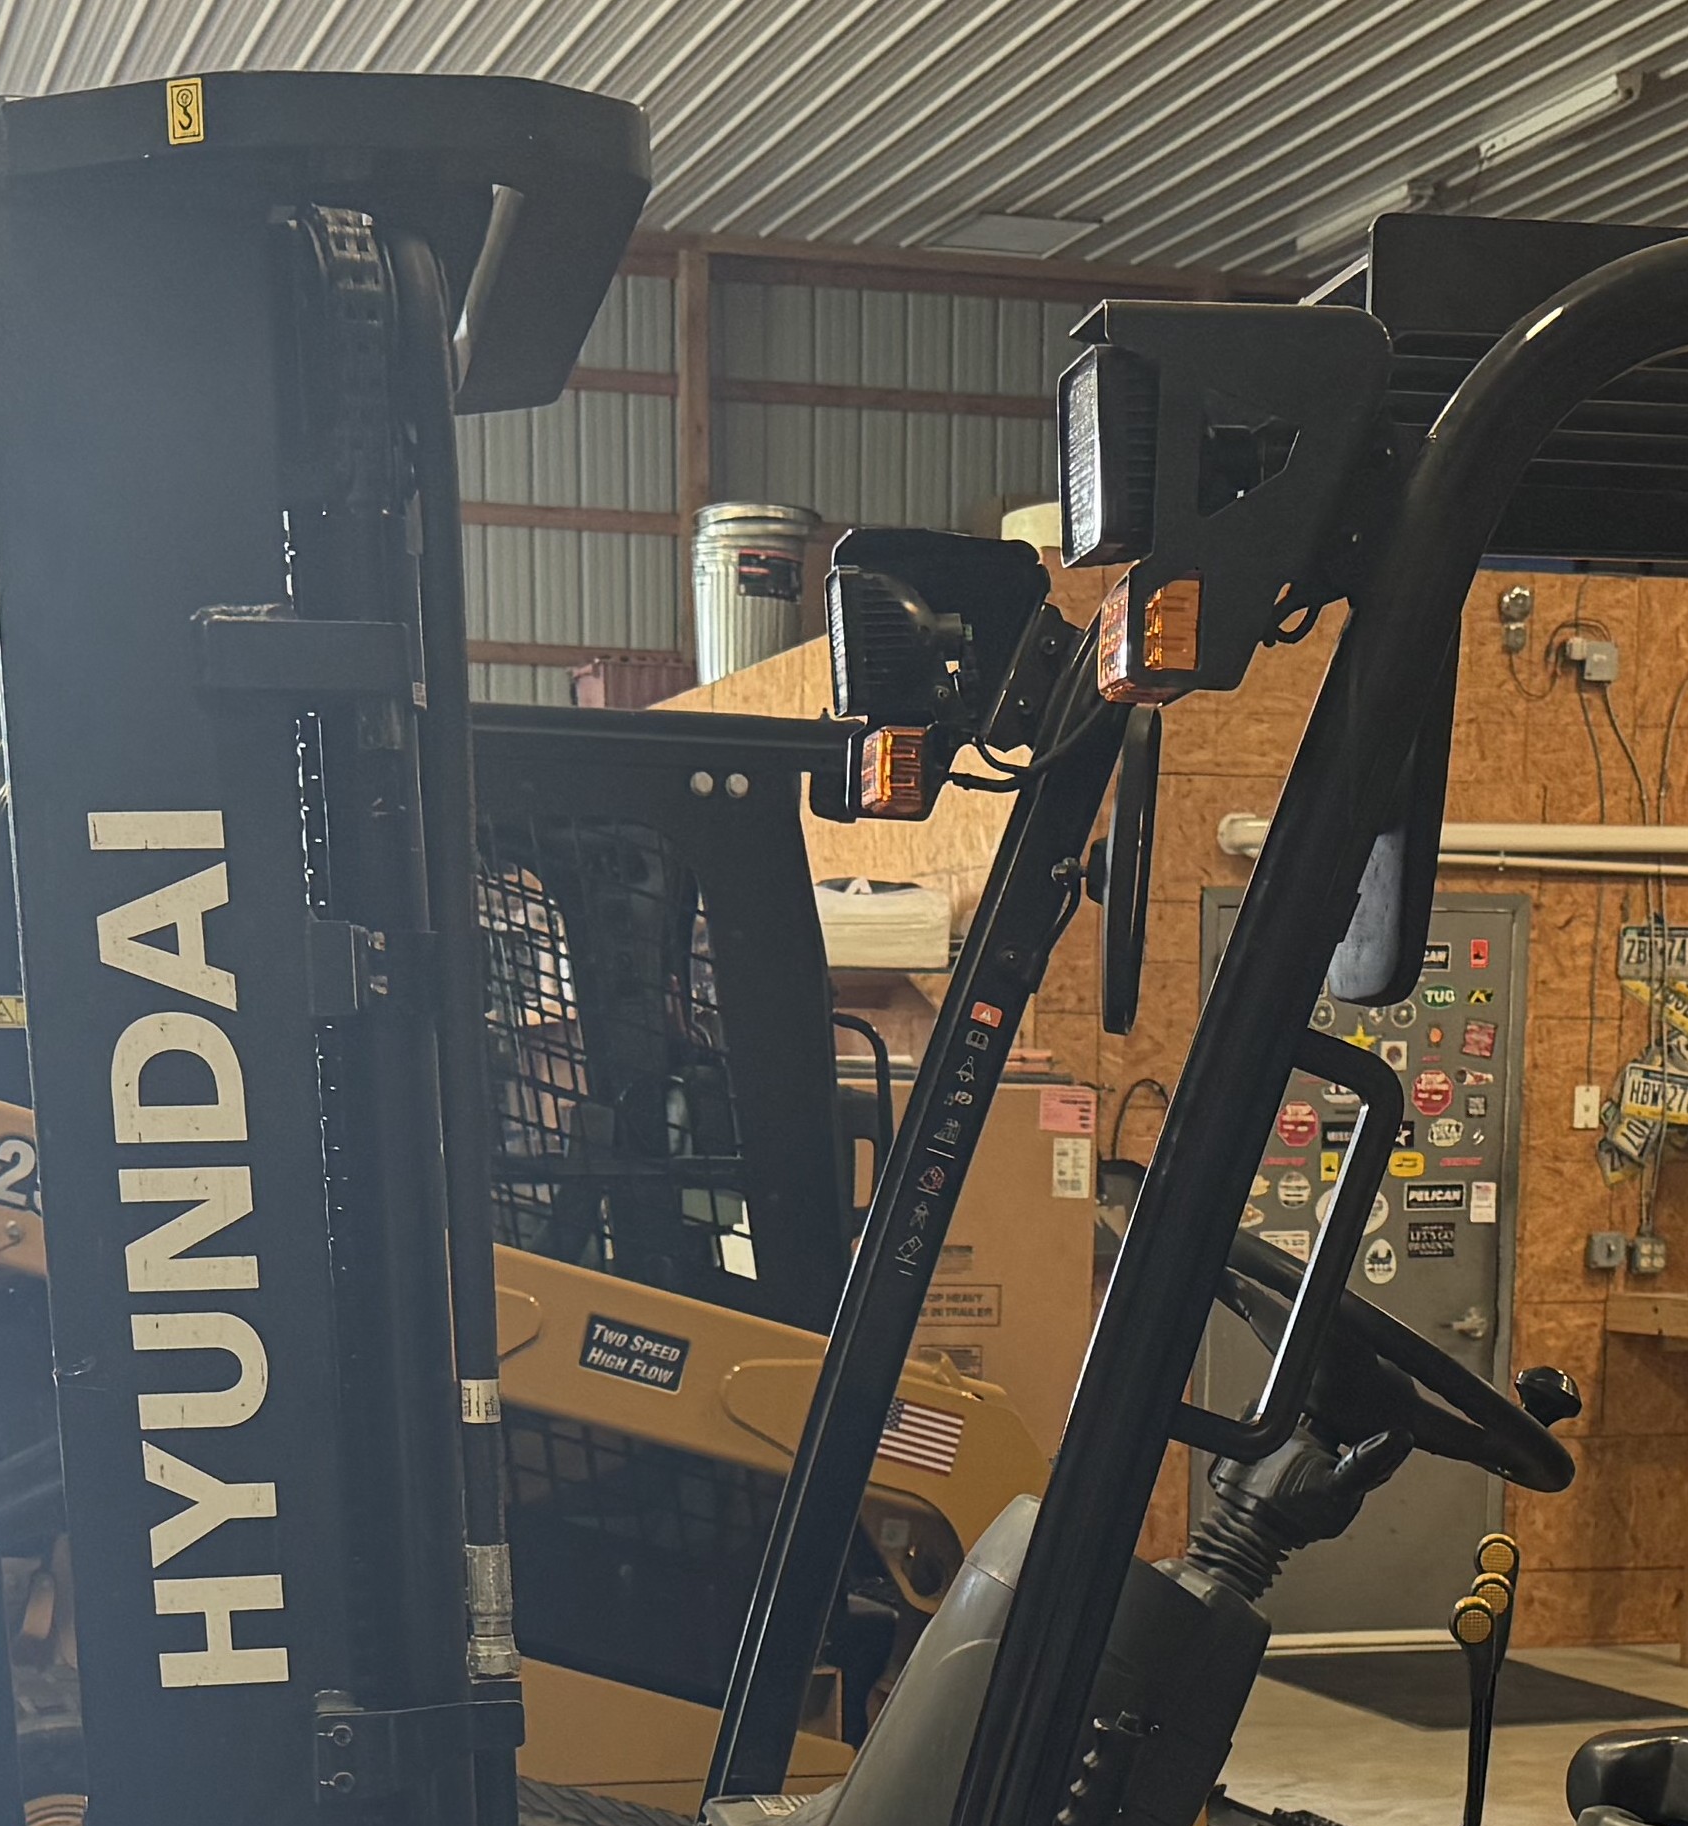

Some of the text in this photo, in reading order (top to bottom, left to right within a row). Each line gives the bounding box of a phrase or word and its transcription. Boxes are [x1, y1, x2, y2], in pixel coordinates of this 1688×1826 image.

[1408, 1189, 1462, 1201] PELICAN
[87, 810, 290, 1689] HYUNDAI
[946, 1307, 992, 1317] TRAILER
[592, 1323, 681, 1362] TWO SPEED
[586, 1346, 674, 1384] HIGH FLOW
